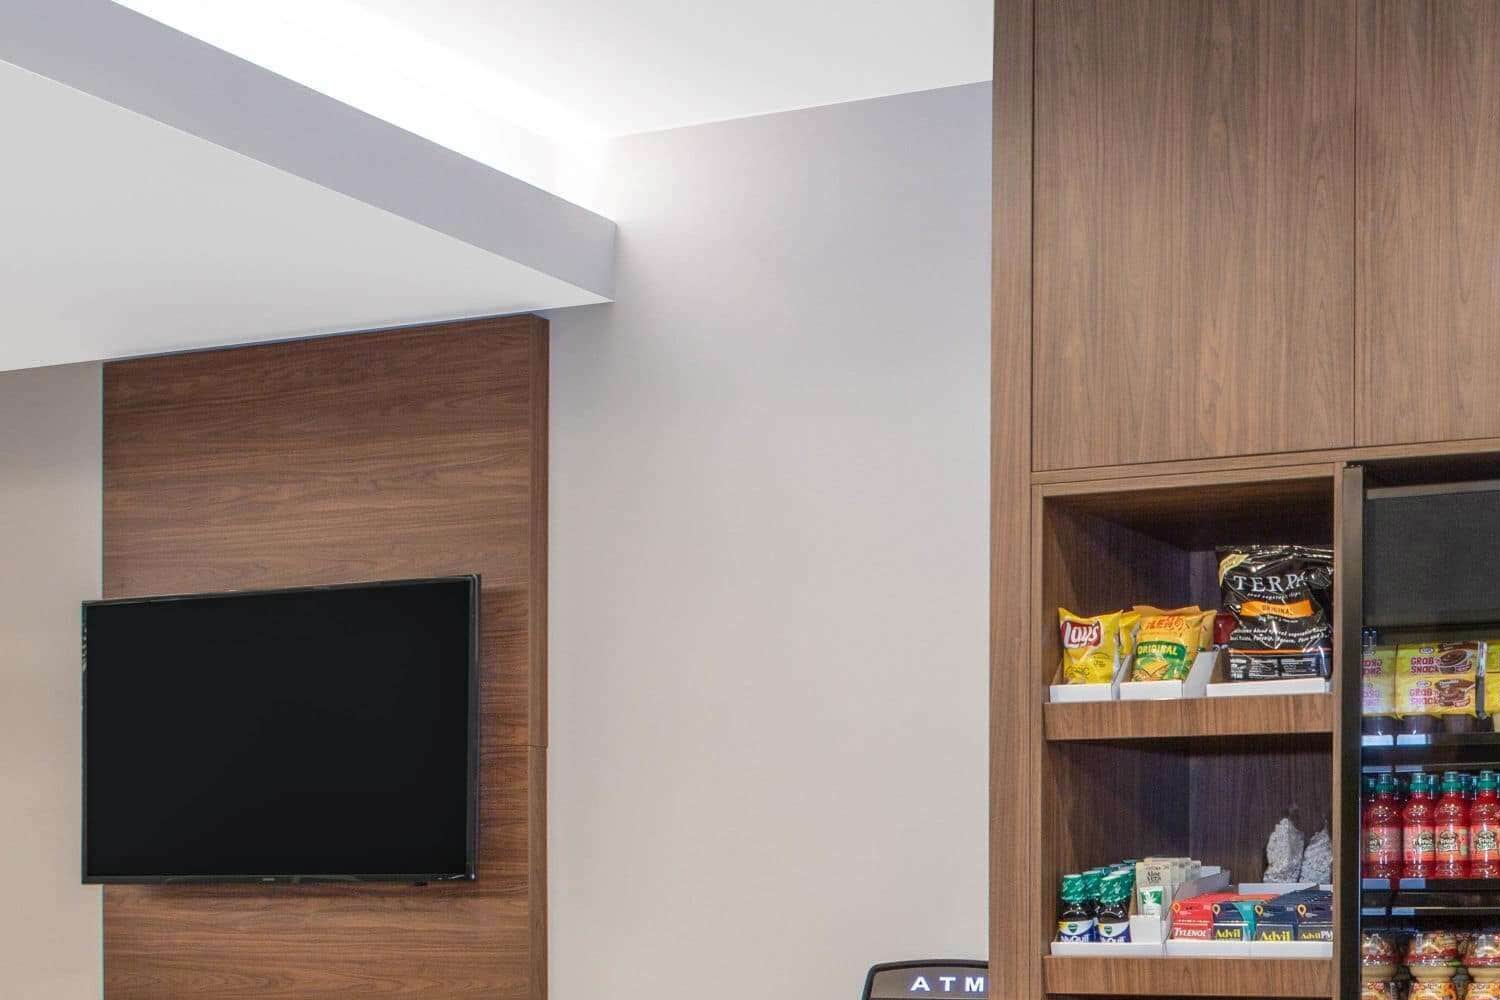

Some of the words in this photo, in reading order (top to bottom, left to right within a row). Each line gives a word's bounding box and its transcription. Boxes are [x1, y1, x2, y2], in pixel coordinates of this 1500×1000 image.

[1216, 929, 1241, 938] Advil
[1261, 931, 1291, 941] Advil
[910, 976, 984, 992] ATM
